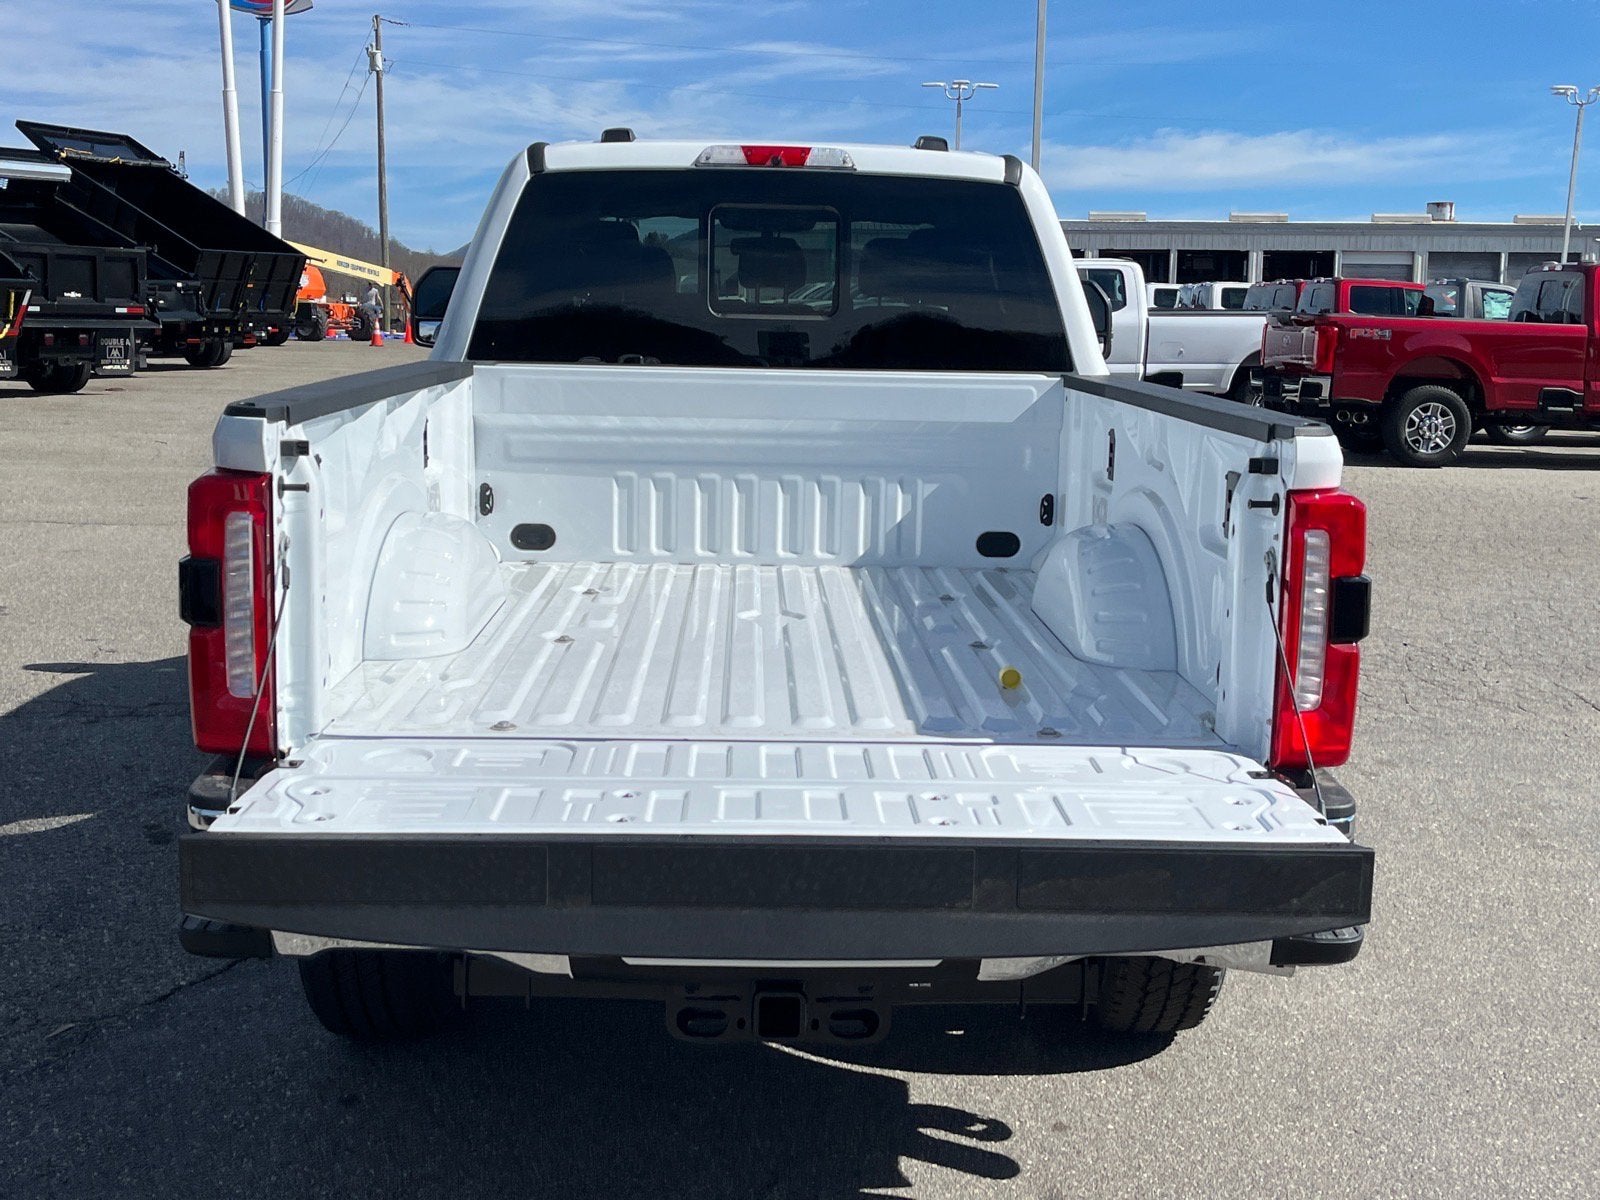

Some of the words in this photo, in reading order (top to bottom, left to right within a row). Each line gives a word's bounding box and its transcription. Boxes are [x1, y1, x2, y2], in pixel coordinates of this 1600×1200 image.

[1350, 328, 1392, 340] FX4
[100, 338, 124, 346] DOUBLE
[125, 338, 131, 346] A
